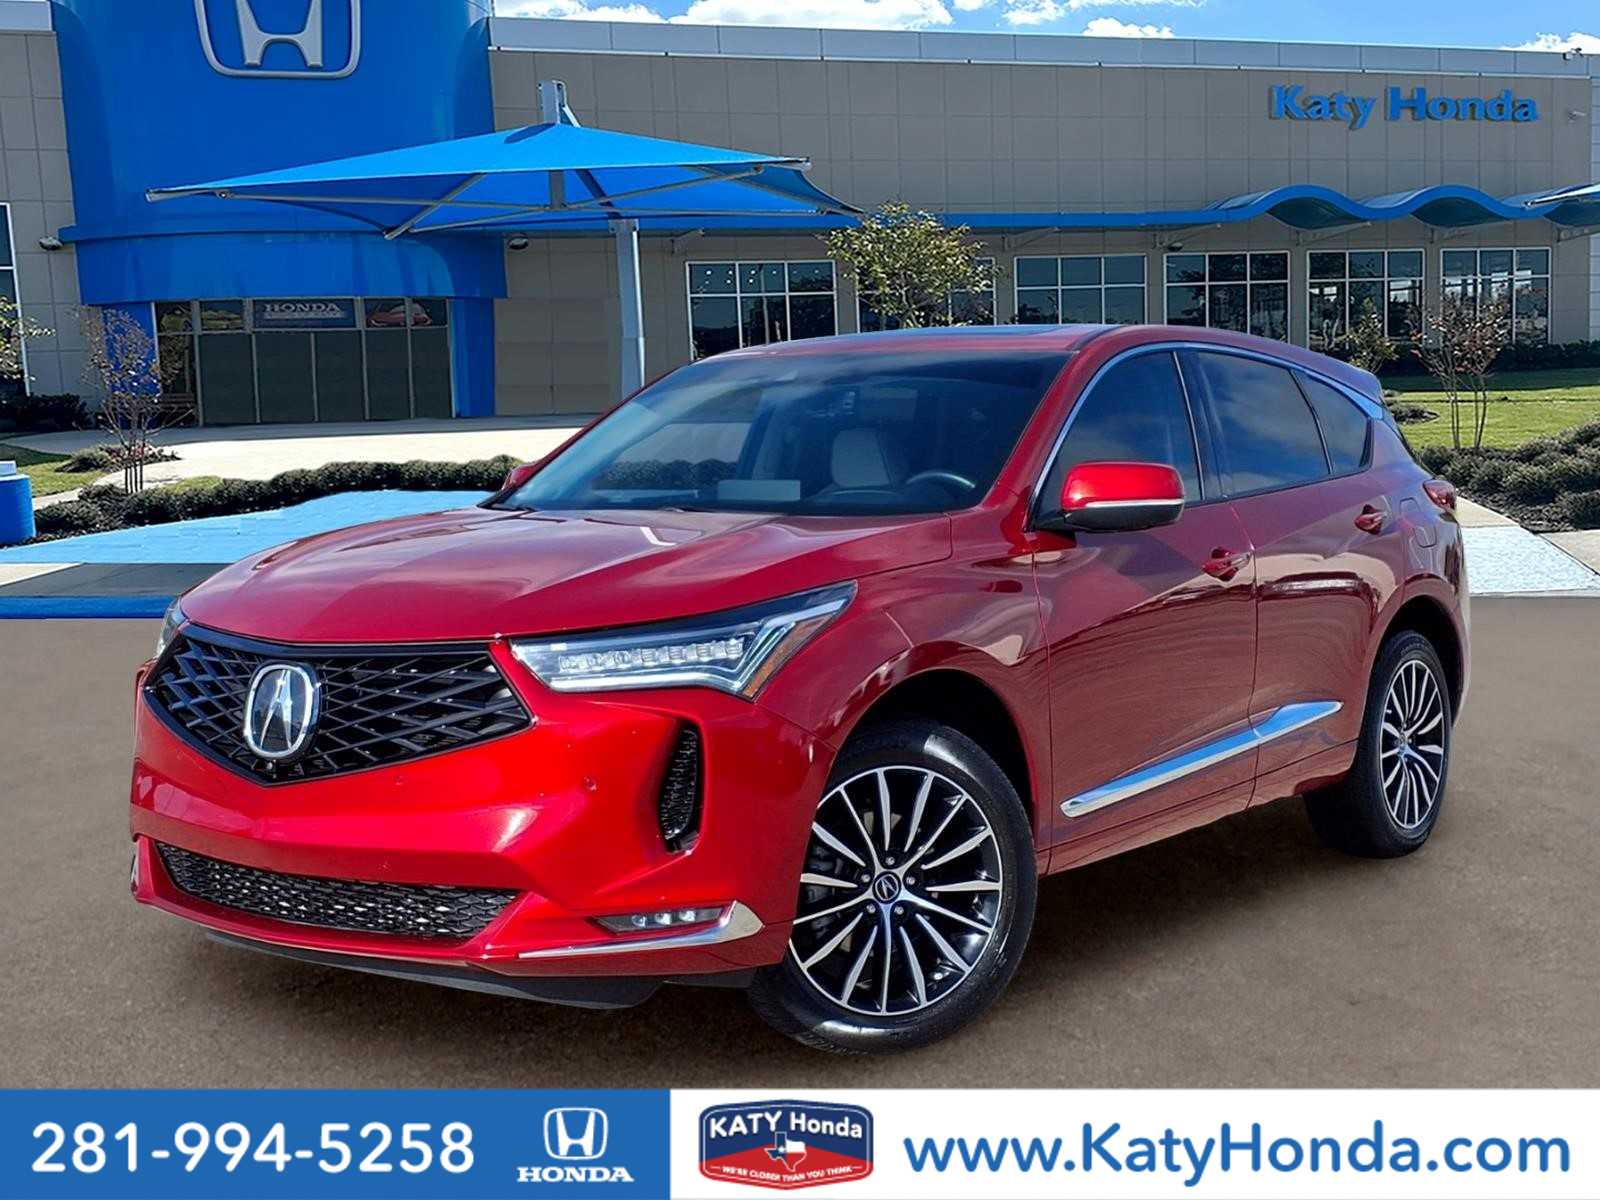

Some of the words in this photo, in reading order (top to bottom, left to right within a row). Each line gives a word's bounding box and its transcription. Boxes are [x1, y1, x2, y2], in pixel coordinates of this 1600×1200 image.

[1270, 85, 1377, 130] Katy
[1385, 86, 1539, 122] Honda
[264, 302, 341, 313] HONDA
